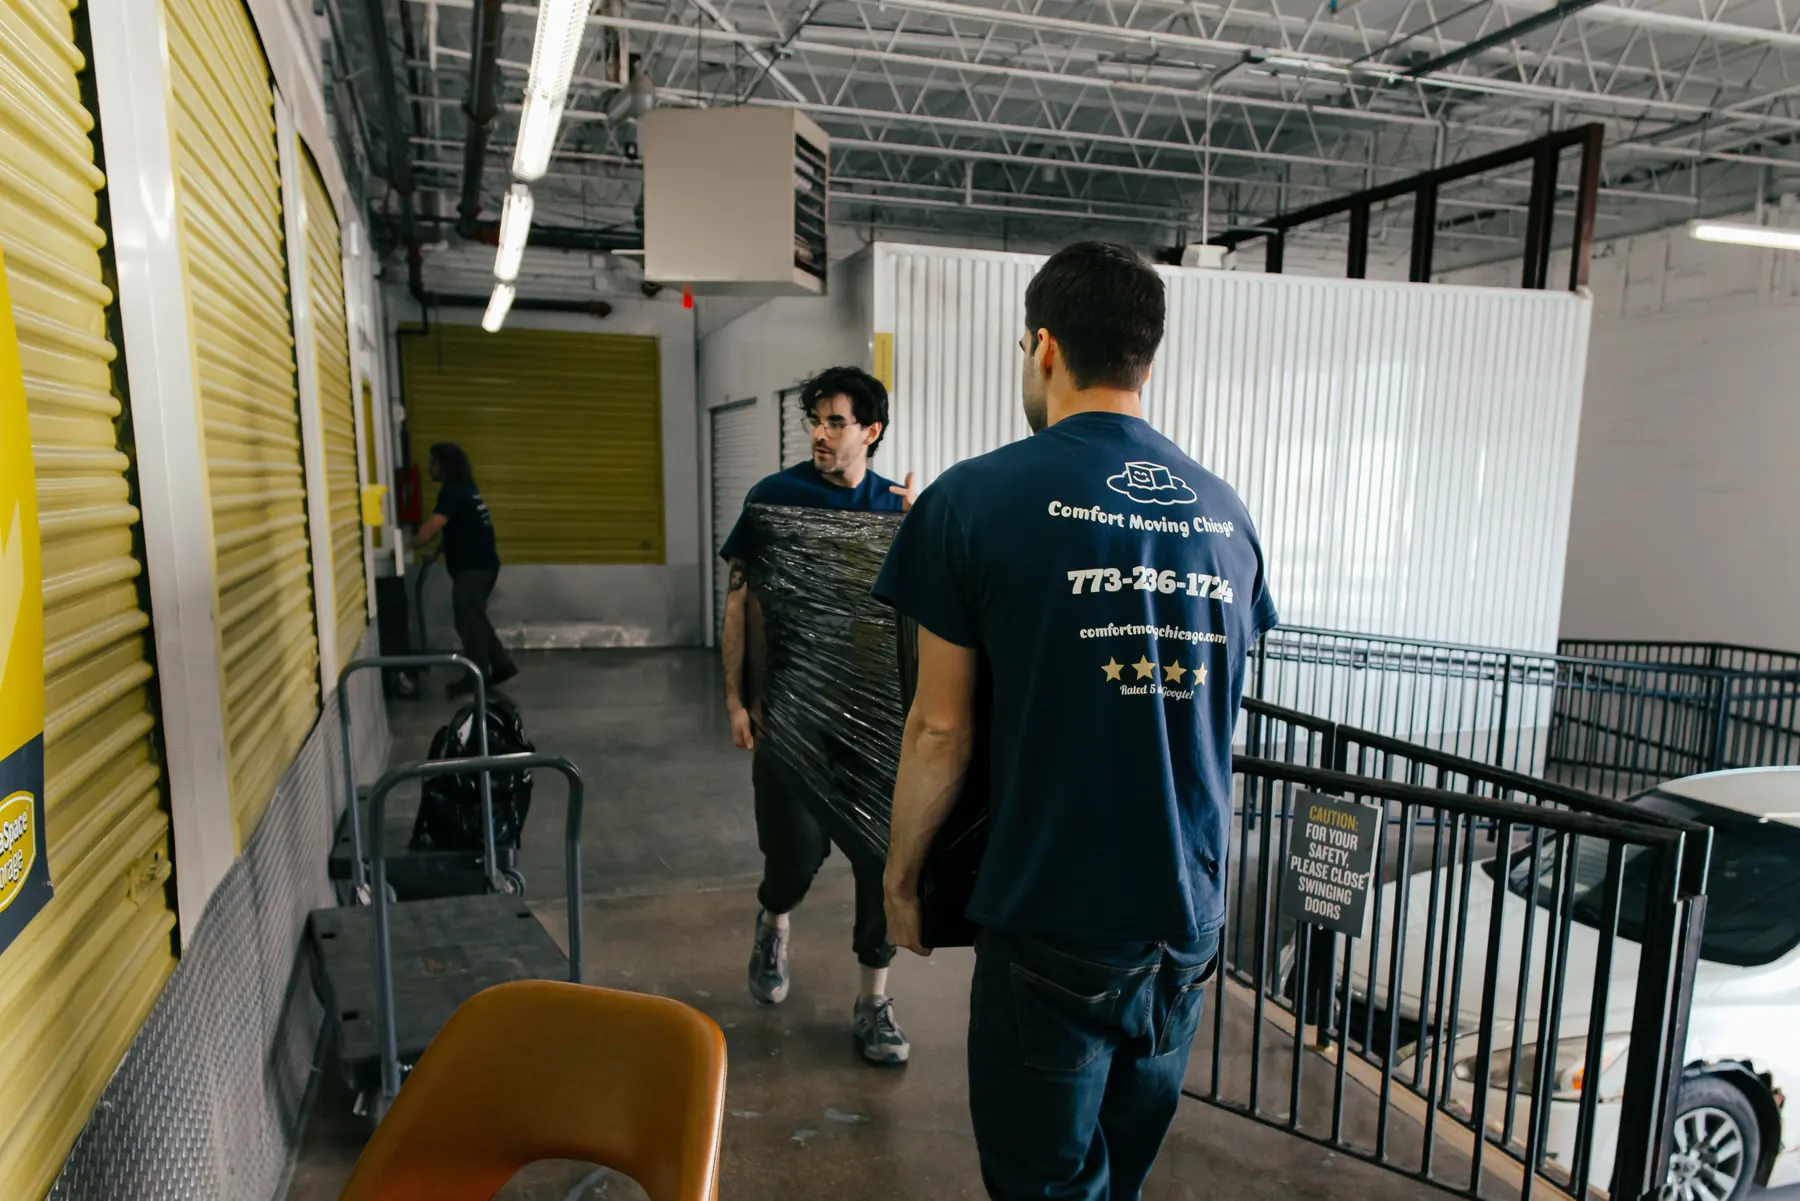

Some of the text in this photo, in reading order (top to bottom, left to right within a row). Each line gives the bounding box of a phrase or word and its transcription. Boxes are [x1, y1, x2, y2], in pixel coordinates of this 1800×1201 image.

[1048, 500, 1234, 538] Comfort Moving Chicago
[1067, 565, 1234, 604] 773-236-1724
[1120, 684, 1148, 696] Rated
[1149, 683, 1156, 694] 5
[1309, 805, 1359, 832] CAUTION:
[1305, 822, 1358, 851] FOR YOUR
[1308, 842, 1349, 869] SAFETY,
[1290, 855, 1364, 890] PLEASE CLOSE
[1298, 876, 1352, 905] SWINGING
[1304, 896, 1341, 921] DOORS
